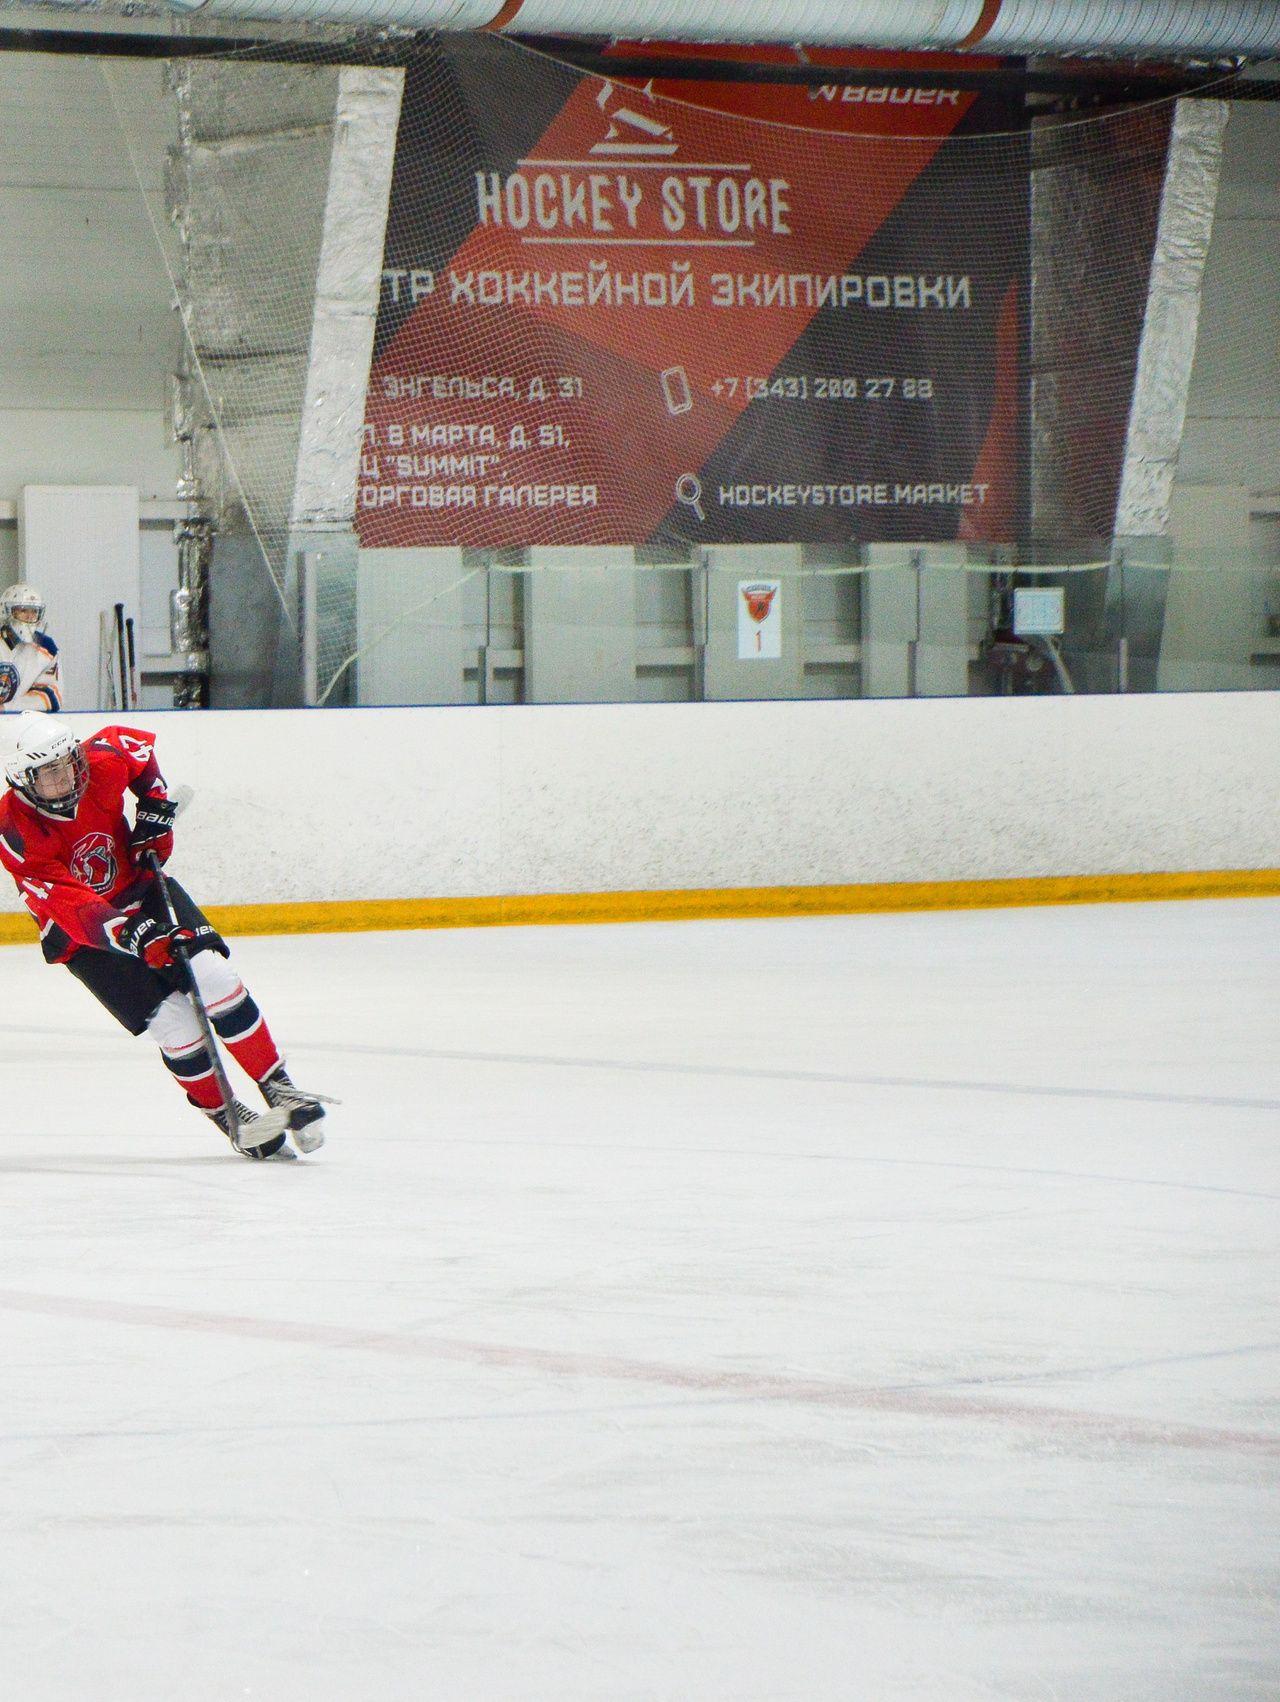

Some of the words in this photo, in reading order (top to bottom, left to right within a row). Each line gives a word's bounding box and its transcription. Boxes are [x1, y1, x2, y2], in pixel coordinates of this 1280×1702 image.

[475, 171, 642, 231] HOCKEY
[662, 176, 792, 234] STORE
[450, 260, 695, 307] ХОККЕЙНОЙ
[710, 273, 970, 308] ЭКИПИРОВКИ
[558, 377, 583, 398] 31
[711, 377, 740, 398] +7
[814, 377, 858, 398] 200
[865, 377, 896, 398] 27
[388, 424, 404, 446] 8
[411, 424, 502, 448] МАРТА,
[538, 424, 571, 448] 51,
[484, 485, 598, 506] ГАЛЕРЕЯ
[719, 484, 990, 506] HOCKEYSTORE.MARKET
[755, 629, 762, 652] 1
[51, 737, 67, 750] CCM
